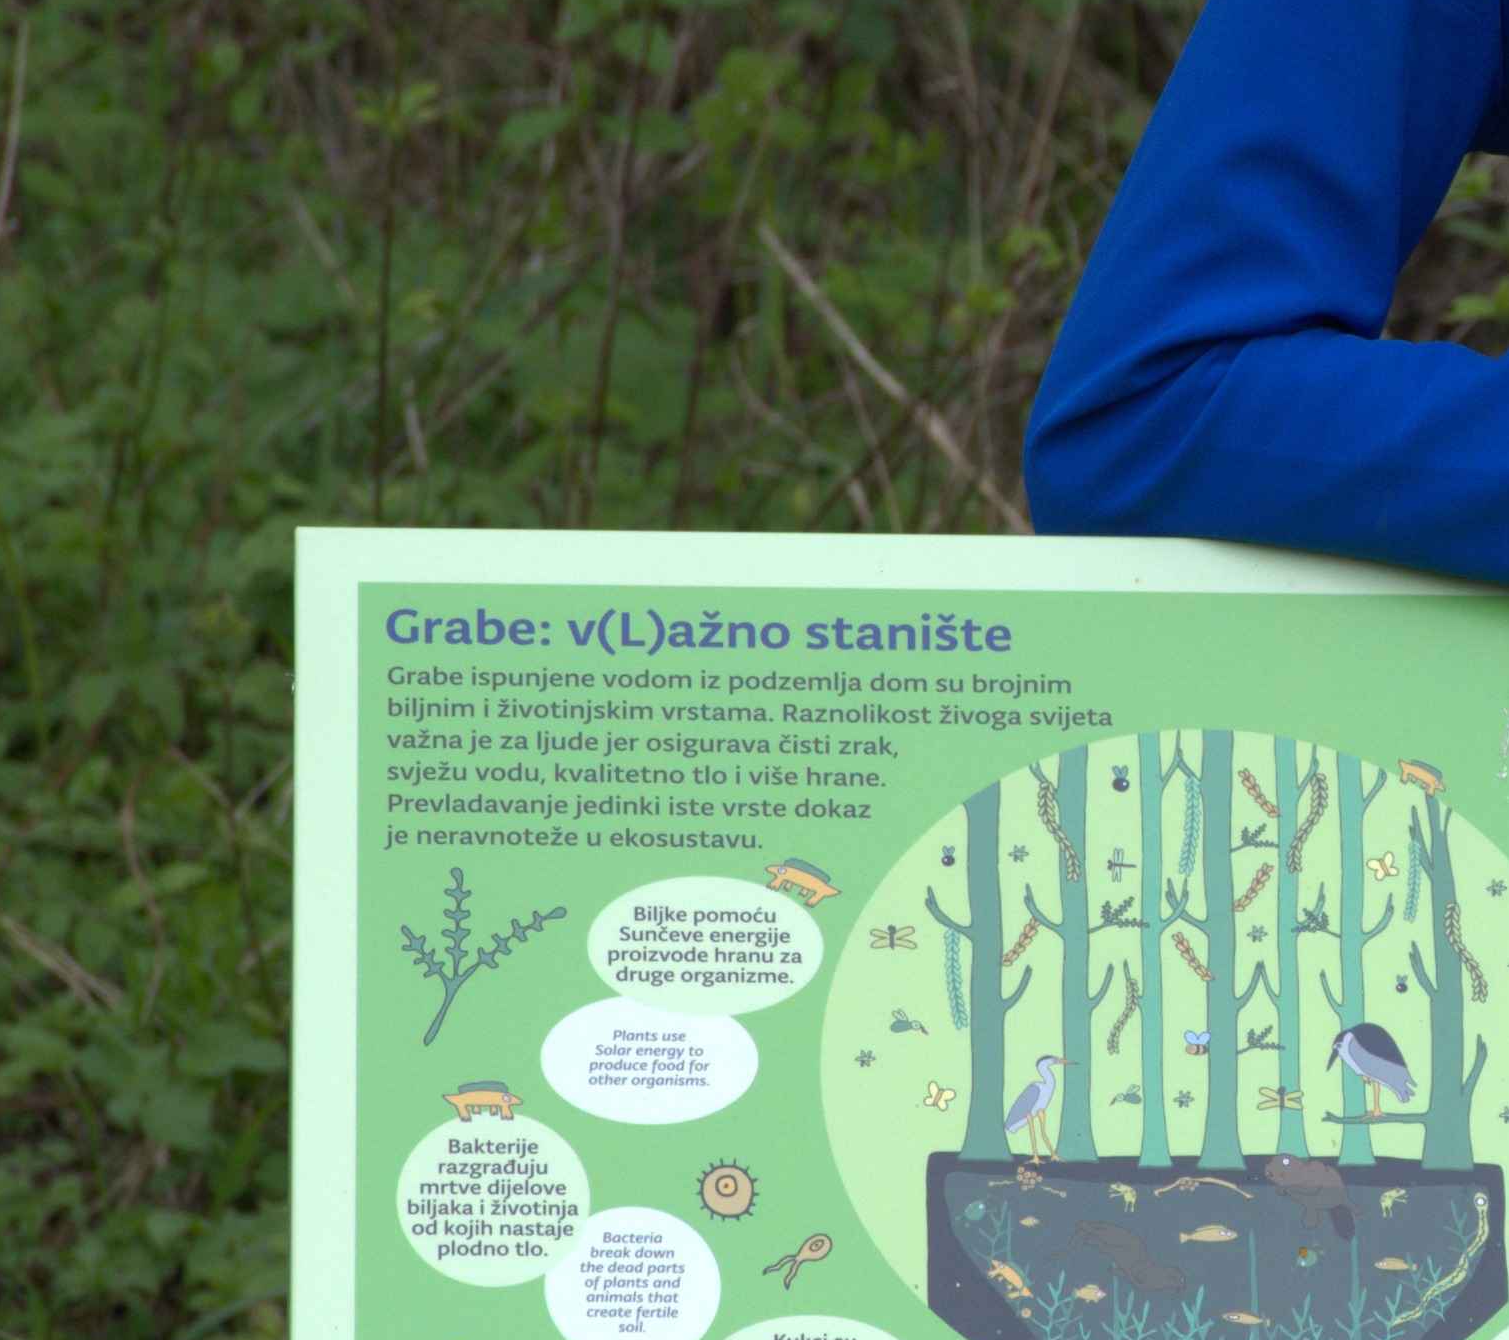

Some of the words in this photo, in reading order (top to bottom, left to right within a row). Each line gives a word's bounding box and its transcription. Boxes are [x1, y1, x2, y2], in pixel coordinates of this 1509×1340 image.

[385, 606, 551, 647] Grabe:
[567, 608, 791, 659] v(L)ažno
[806, 611, 1012, 652] stanište
[387, 665, 464, 687] Grabe
[471, 667, 595, 693] ispunjene
[602, 667, 693, 690] vodom
[701, 670, 721, 690] iz
[729, 669, 863, 697] podzemlja
[870, 671, 928, 693] dom
[935, 678, 964, 693] su
[972, 672, 1072, 699] brojnim
[388, 697, 475, 724] biljnim
[484, 699, 489, 719] i
[497, 698, 654, 726] životinjskim
[660, 703, 774, 723] vrstama.
[783, 702, 932, 724] Raznolikost
[939, 703, 1023, 730] živoga
[1030, 706, 1114, 731] svijeta
[387, 728, 463, 750] važna
[471, 730, 493, 756] je
[499, 736, 530, 751] za
[537, 730, 599, 757] ljude
[607, 732, 640, 757] jer
[646, 732, 771, 759] osigurava
[778, 733, 831, 754] čisti
[838, 733, 899, 758] zrak,
[387, 760, 467, 787] svježu
[475, 761, 546, 786] vodu,
[554, 762, 685, 785] kvalitetno
[692, 764, 728, 785] tlo
[735, 765, 741, 785] i
[748, 764, 799, 786] više
[806, 765, 887, 787] hrane.
[388, 792, 569, 820] Prevladavanje
[576, 794, 660, 821] jedinki
[669, 796, 715, 817] iste
[722, 798, 787, 817] vrste
[794, 796, 872, 818] dokaz
[383, 825, 409, 850] je
[417, 824, 579, 847] neravnoteže
[587, 832, 601, 847] u
[609, 826, 763, 849] ekosustavu.
[634, 905, 688, 926] Biljke
[693, 906, 777, 927] pomoću
[619, 925, 704, 943] Sunčeve
[709, 927, 791, 947] energije
[607, 945, 709, 967] proizvode
[714, 946, 775, 963] hranu
[780, 951, 803, 964] za
[615, 965, 675, 987] druge
[680, 967, 795, 988] organizme.
[448, 1137, 539, 1159] Bakterije
[438, 1158, 548, 1180] razgrađuju
[419, 1180, 482, 1195] mrtve
[487, 1178, 567, 1200] dijelove
[407, 1198, 474, 1220] biljaka
[479, 1199, 485, 1216] i
[490, 1199, 579, 1220] životinja
[411, 1218, 438, 1236] od
[444, 1219, 493, 1240] kojih
[499, 1220, 575, 1241] nastaje
[437, 1239, 510, 1261] plodno
[515, 1239, 548, 1257] tlo.
